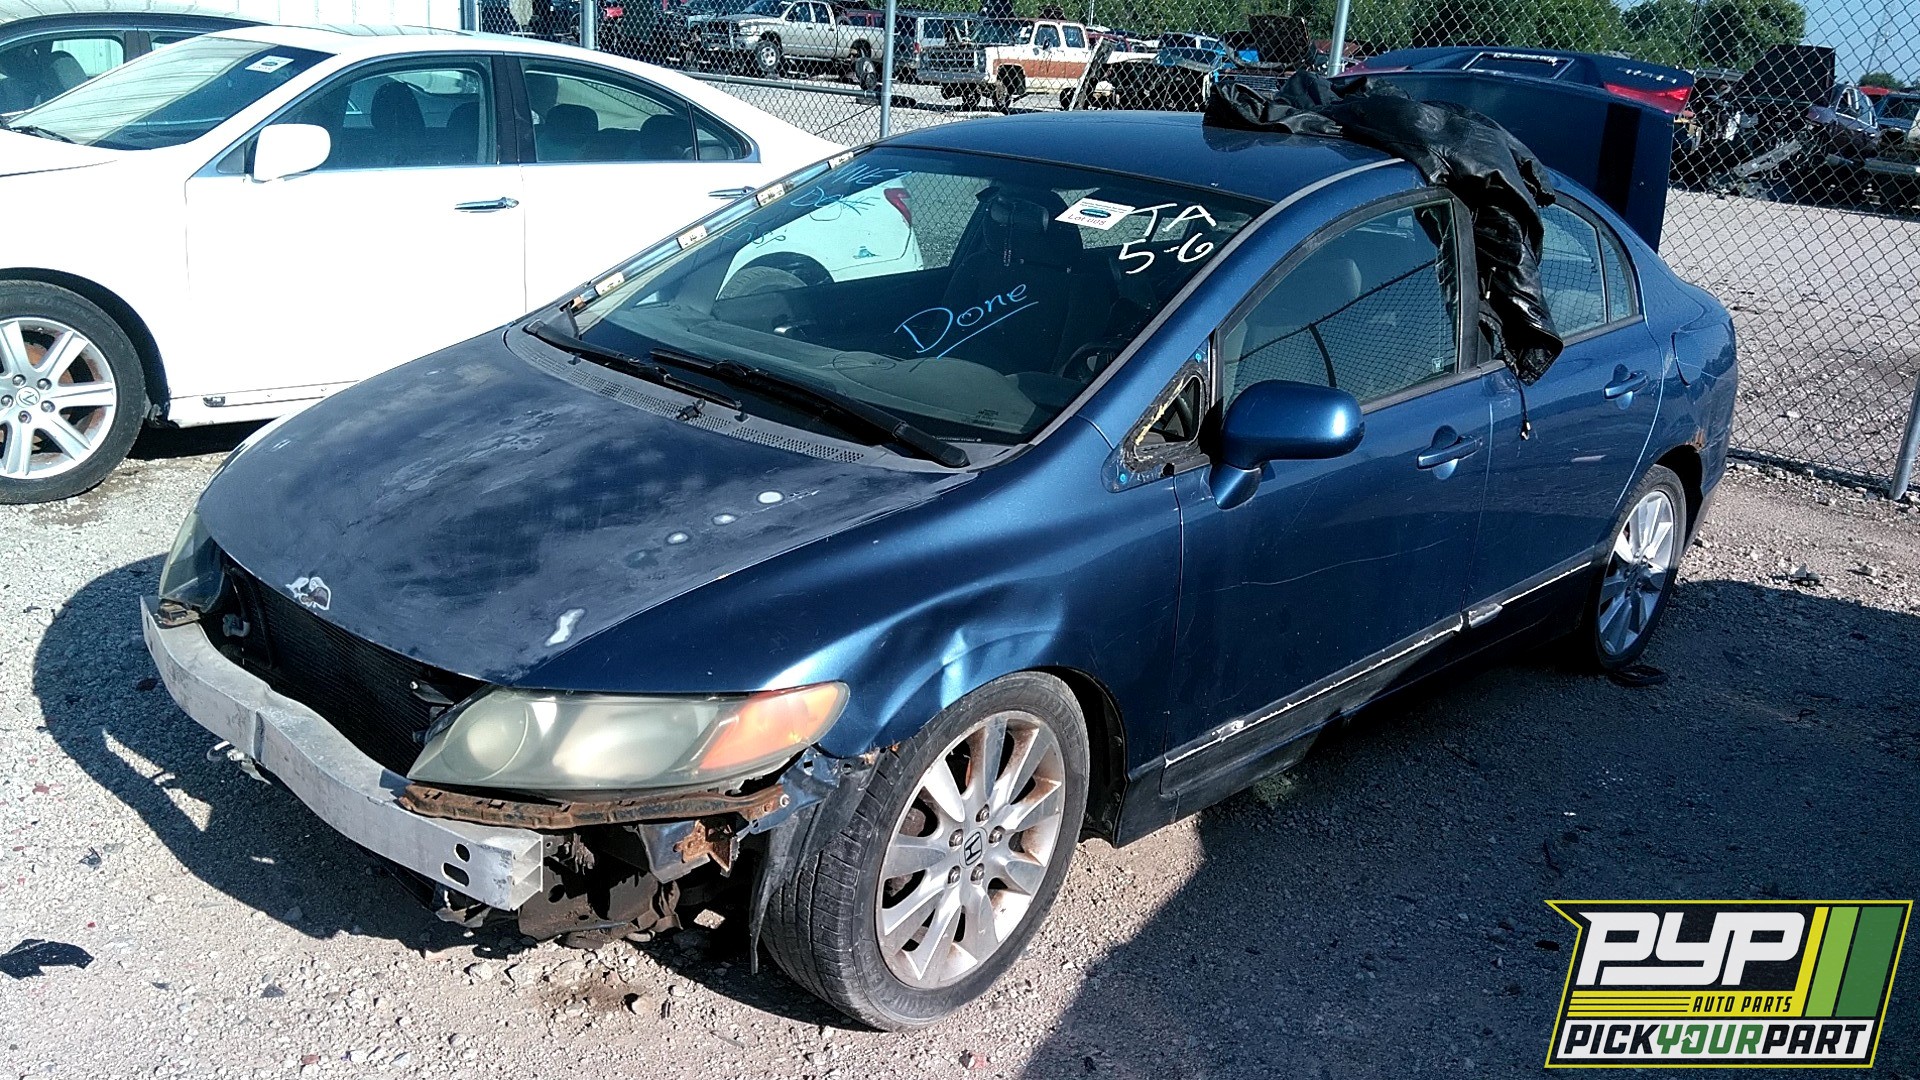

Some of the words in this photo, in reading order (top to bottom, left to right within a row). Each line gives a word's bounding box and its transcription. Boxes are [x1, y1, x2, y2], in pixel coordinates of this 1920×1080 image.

[1067, 213, 1086, 222] Lot
[1118, 233, 1214, 274] 5-6
[894, 282, 1028, 354] Done
